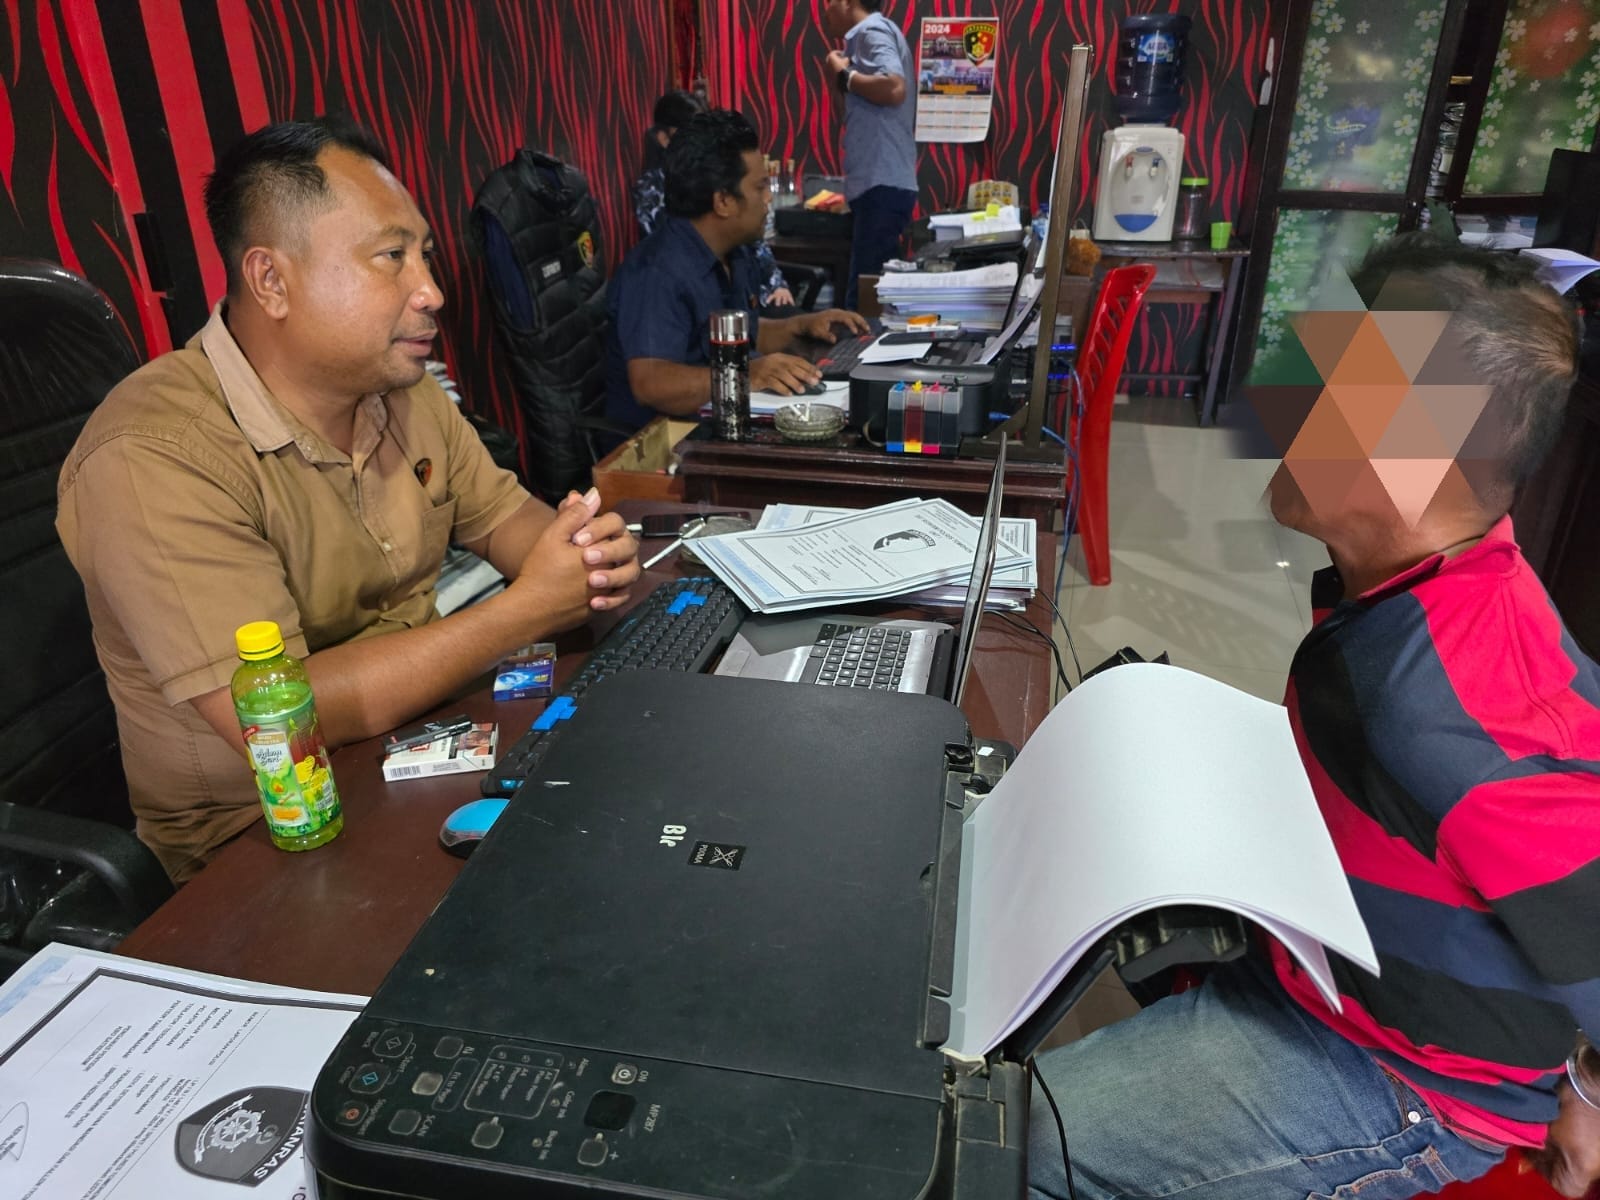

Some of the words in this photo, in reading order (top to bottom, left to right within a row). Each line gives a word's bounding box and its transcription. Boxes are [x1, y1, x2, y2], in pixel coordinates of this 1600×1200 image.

[924, 24, 950, 34] 2024
[638, 1070, 650, 1082] ON
[416, 1114, 436, 1137] SCAN
[644, 1104, 661, 1132] MP287
[254, 1103, 308, 1179] ANRAS
